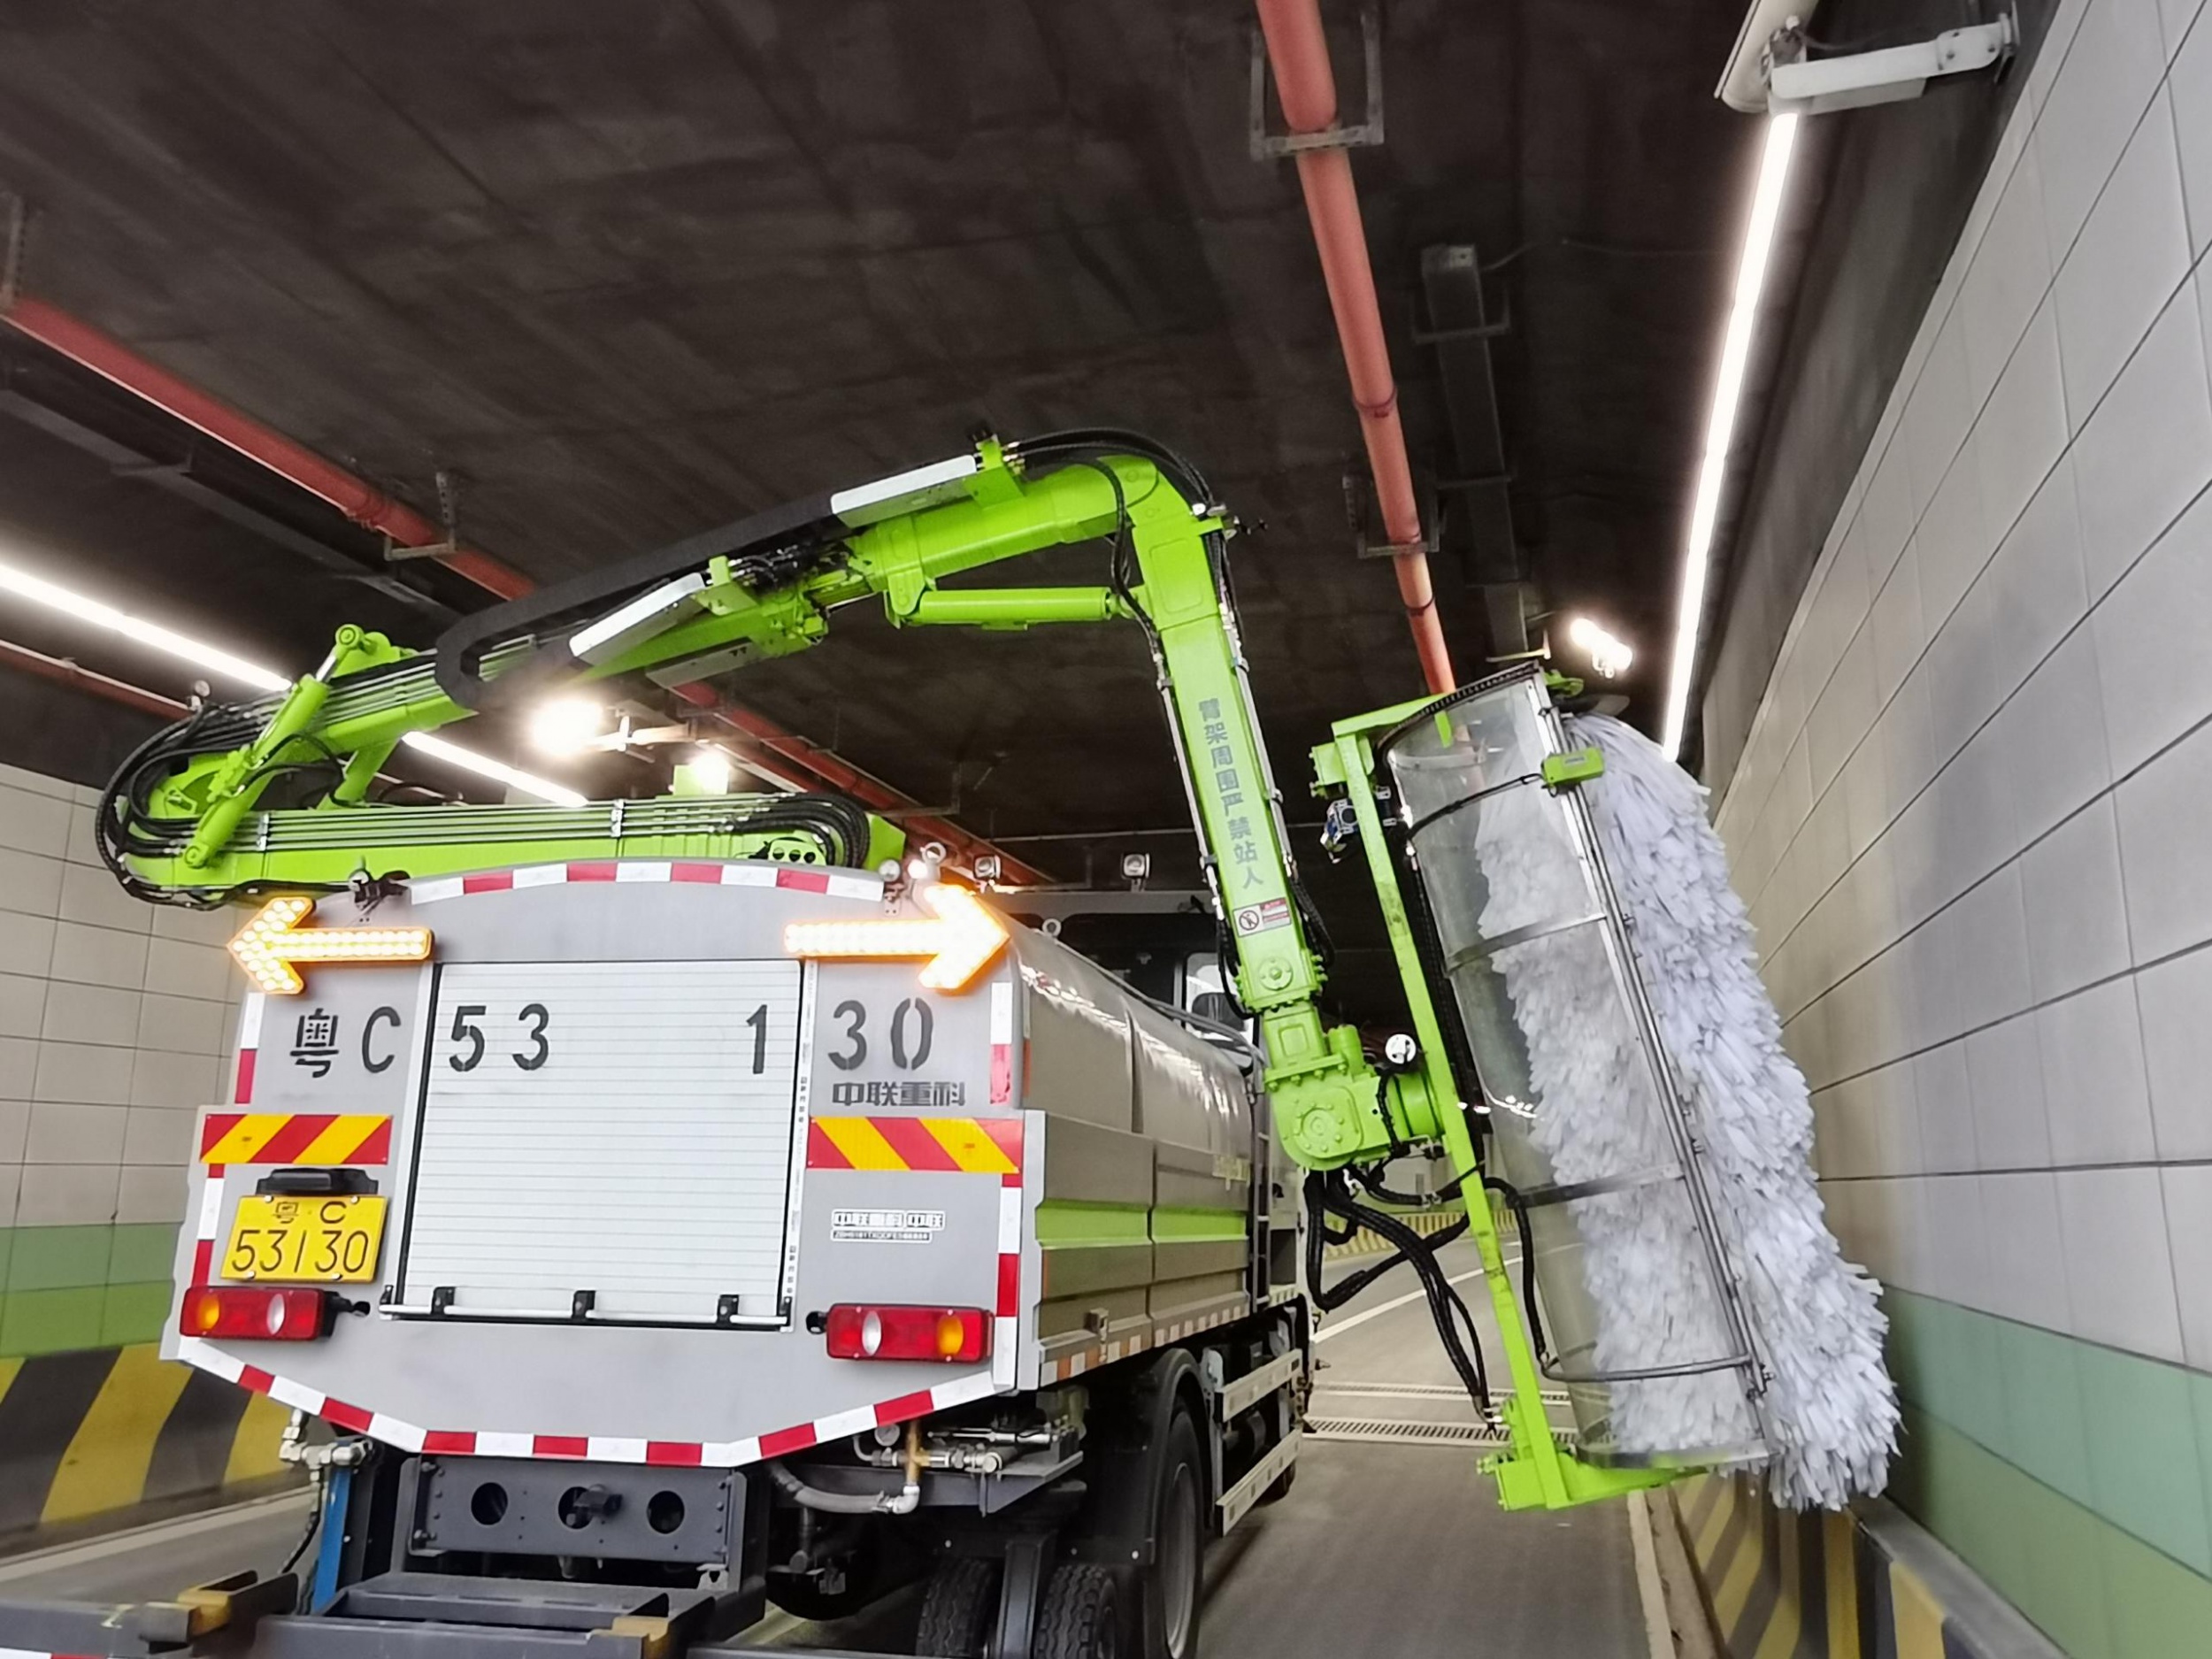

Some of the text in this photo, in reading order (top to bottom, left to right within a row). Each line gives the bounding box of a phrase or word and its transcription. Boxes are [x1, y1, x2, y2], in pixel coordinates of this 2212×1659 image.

[832, 1081, 965, 1106] 中联重科
[232, 1229, 369, 1273] 53130
